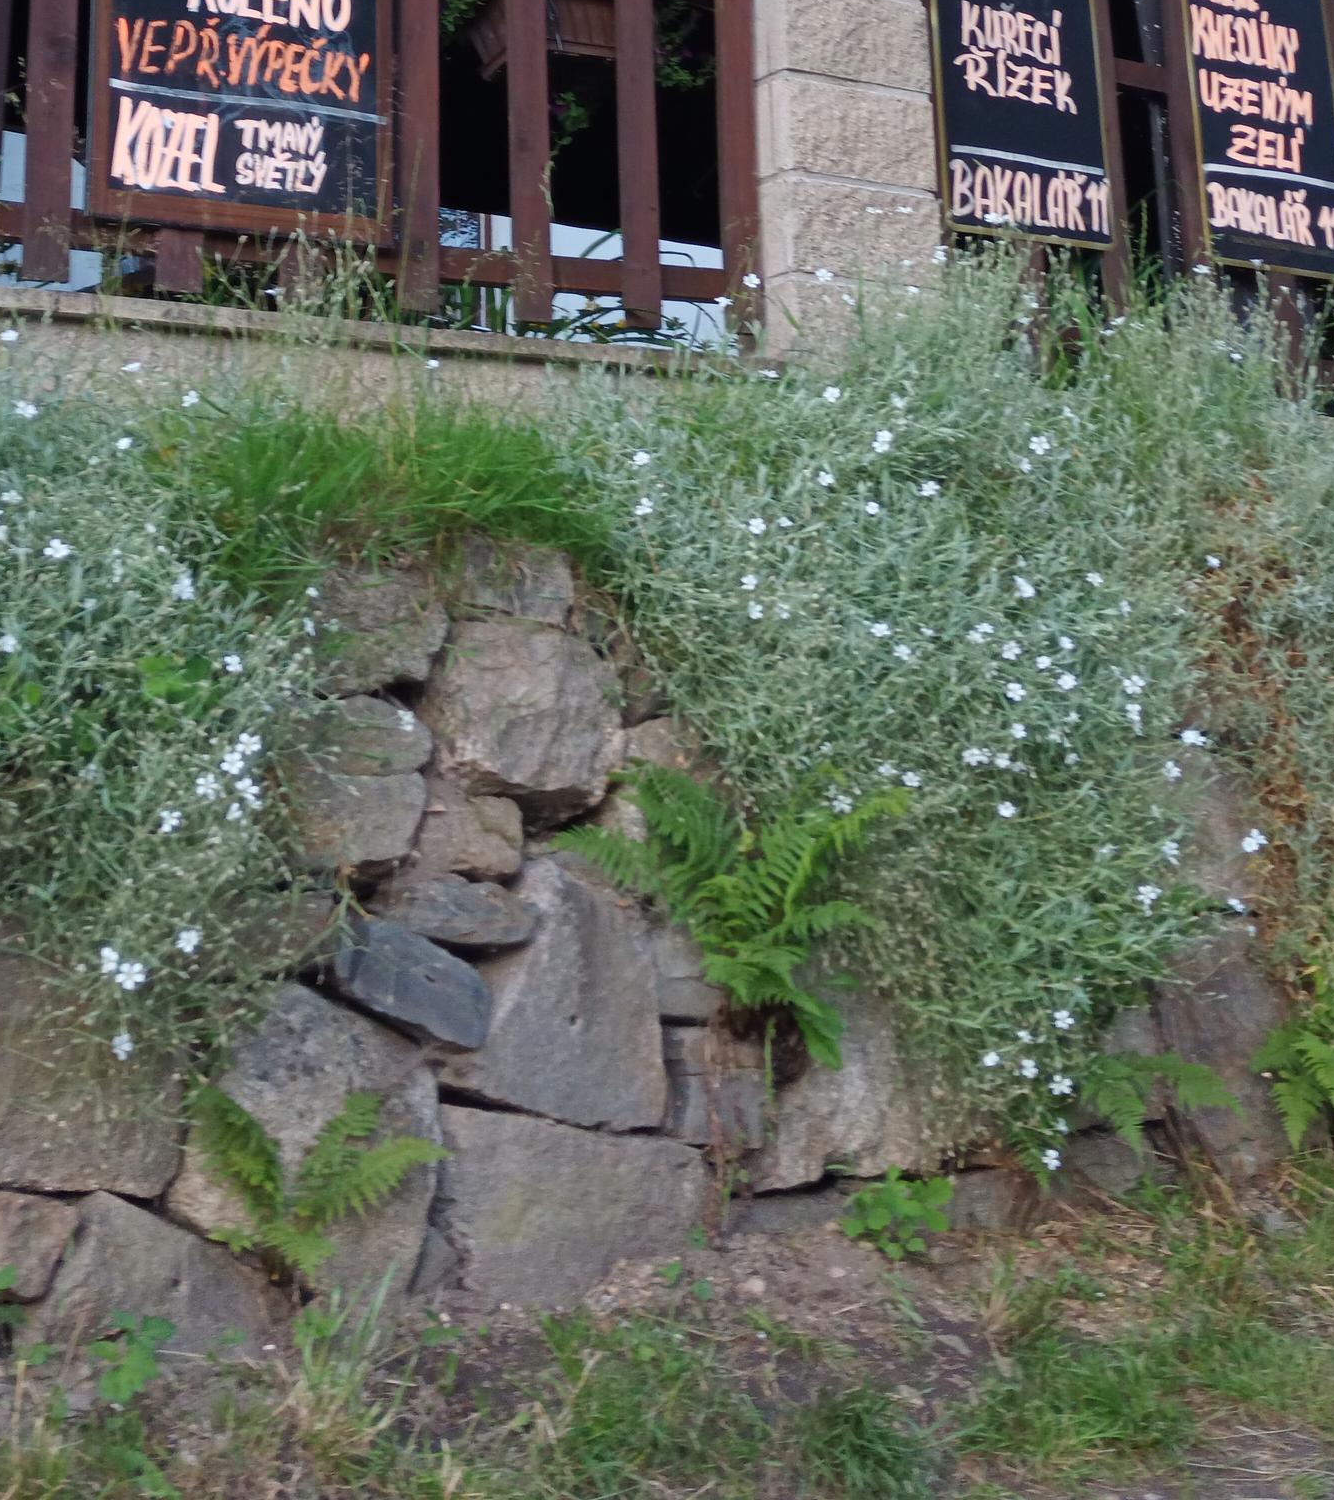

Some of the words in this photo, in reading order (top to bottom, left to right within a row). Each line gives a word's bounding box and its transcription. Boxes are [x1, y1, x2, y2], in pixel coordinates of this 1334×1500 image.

[960, 0, 1063, 67] KUŘECÍ
[1190, 3, 1299, 75] KNEDLÍKY
[953, 49, 1078, 115] ŘÍZEK
[111, 95, 227, 194] KOZEL
[950, 158, 1089, 231] BAKALÁŘ
[1207, 181, 1316, 248] BAKALÁŘ
